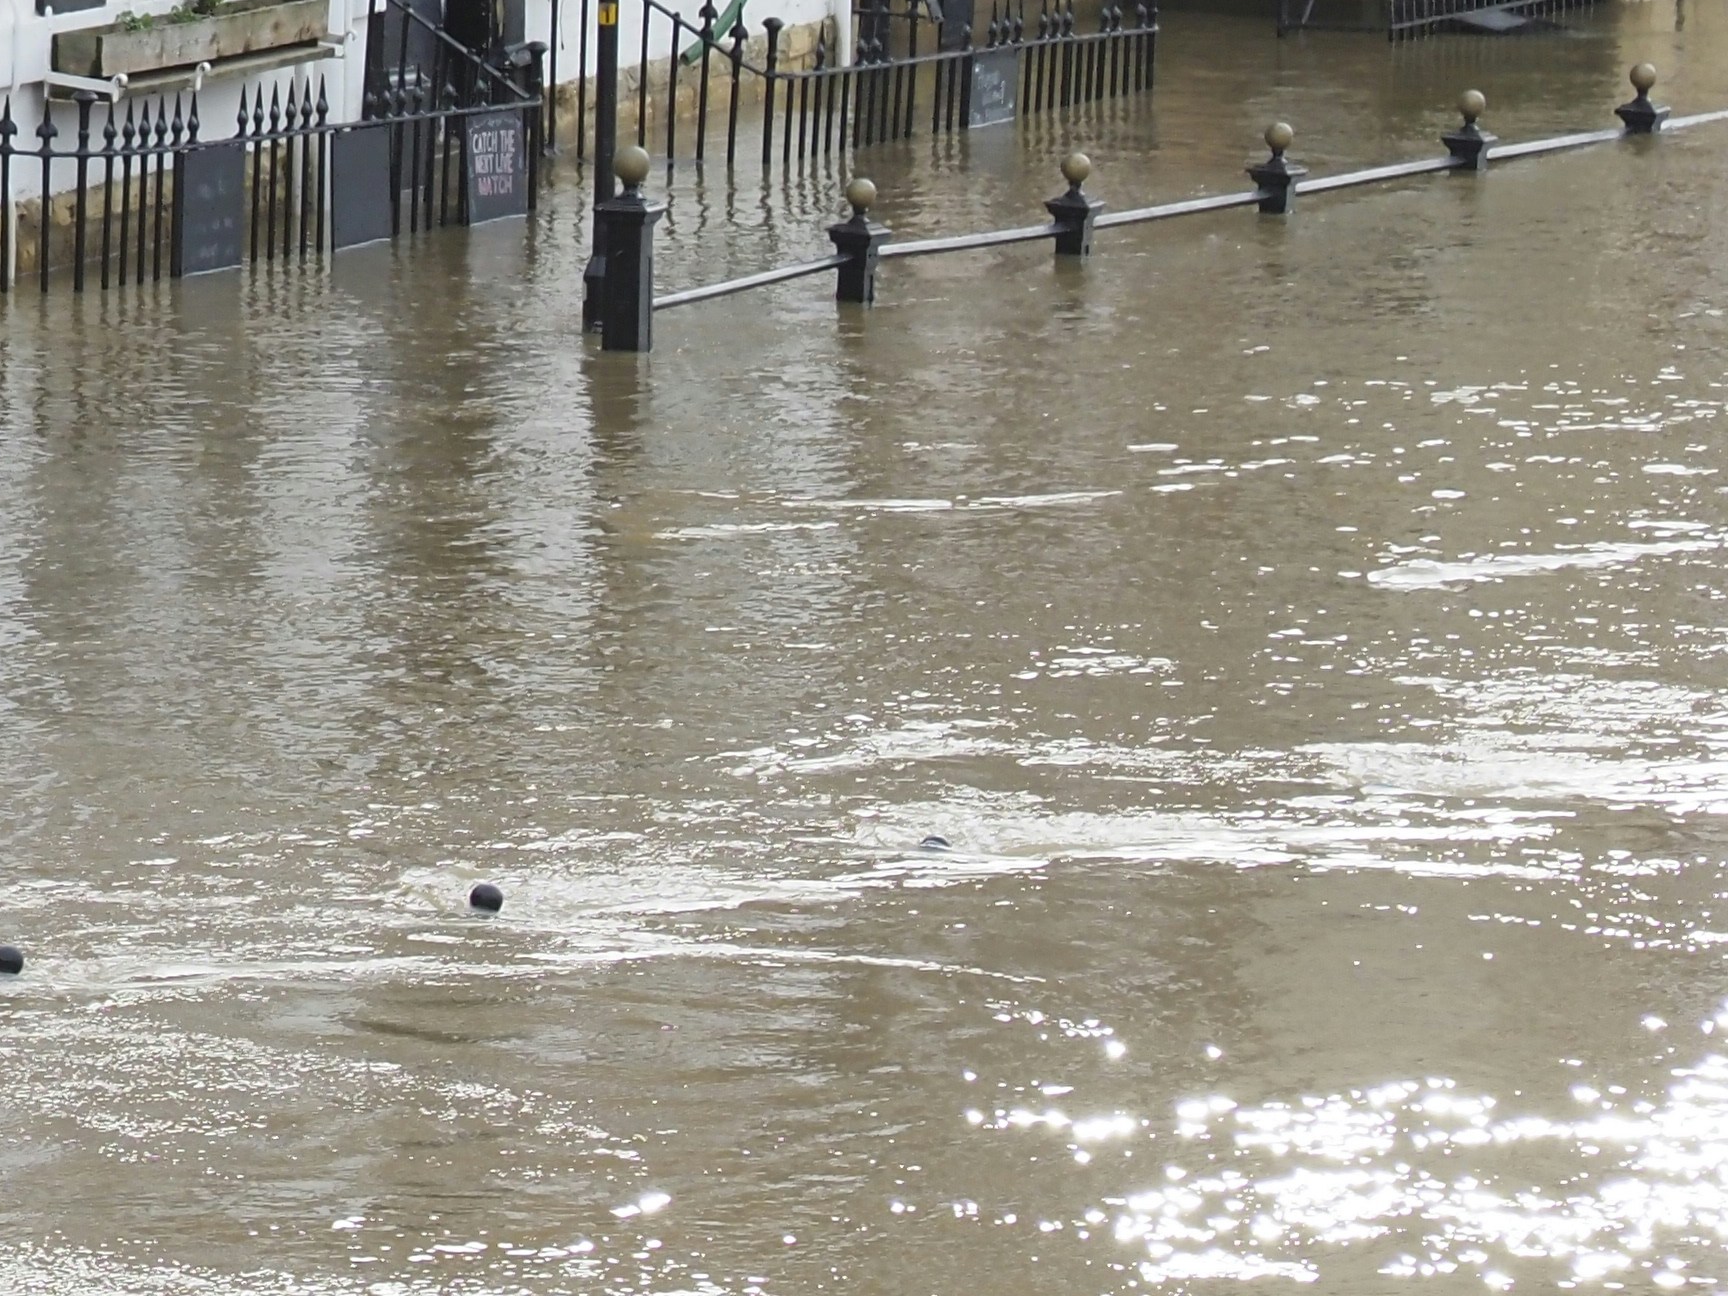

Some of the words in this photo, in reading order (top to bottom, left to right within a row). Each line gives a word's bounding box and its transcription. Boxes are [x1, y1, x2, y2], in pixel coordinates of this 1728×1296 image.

[472, 130, 498, 154] CATCH
[499, 129, 516, 152] THE
[475, 153, 495, 175] NEXT
[495, 152, 514, 175] LIVE
